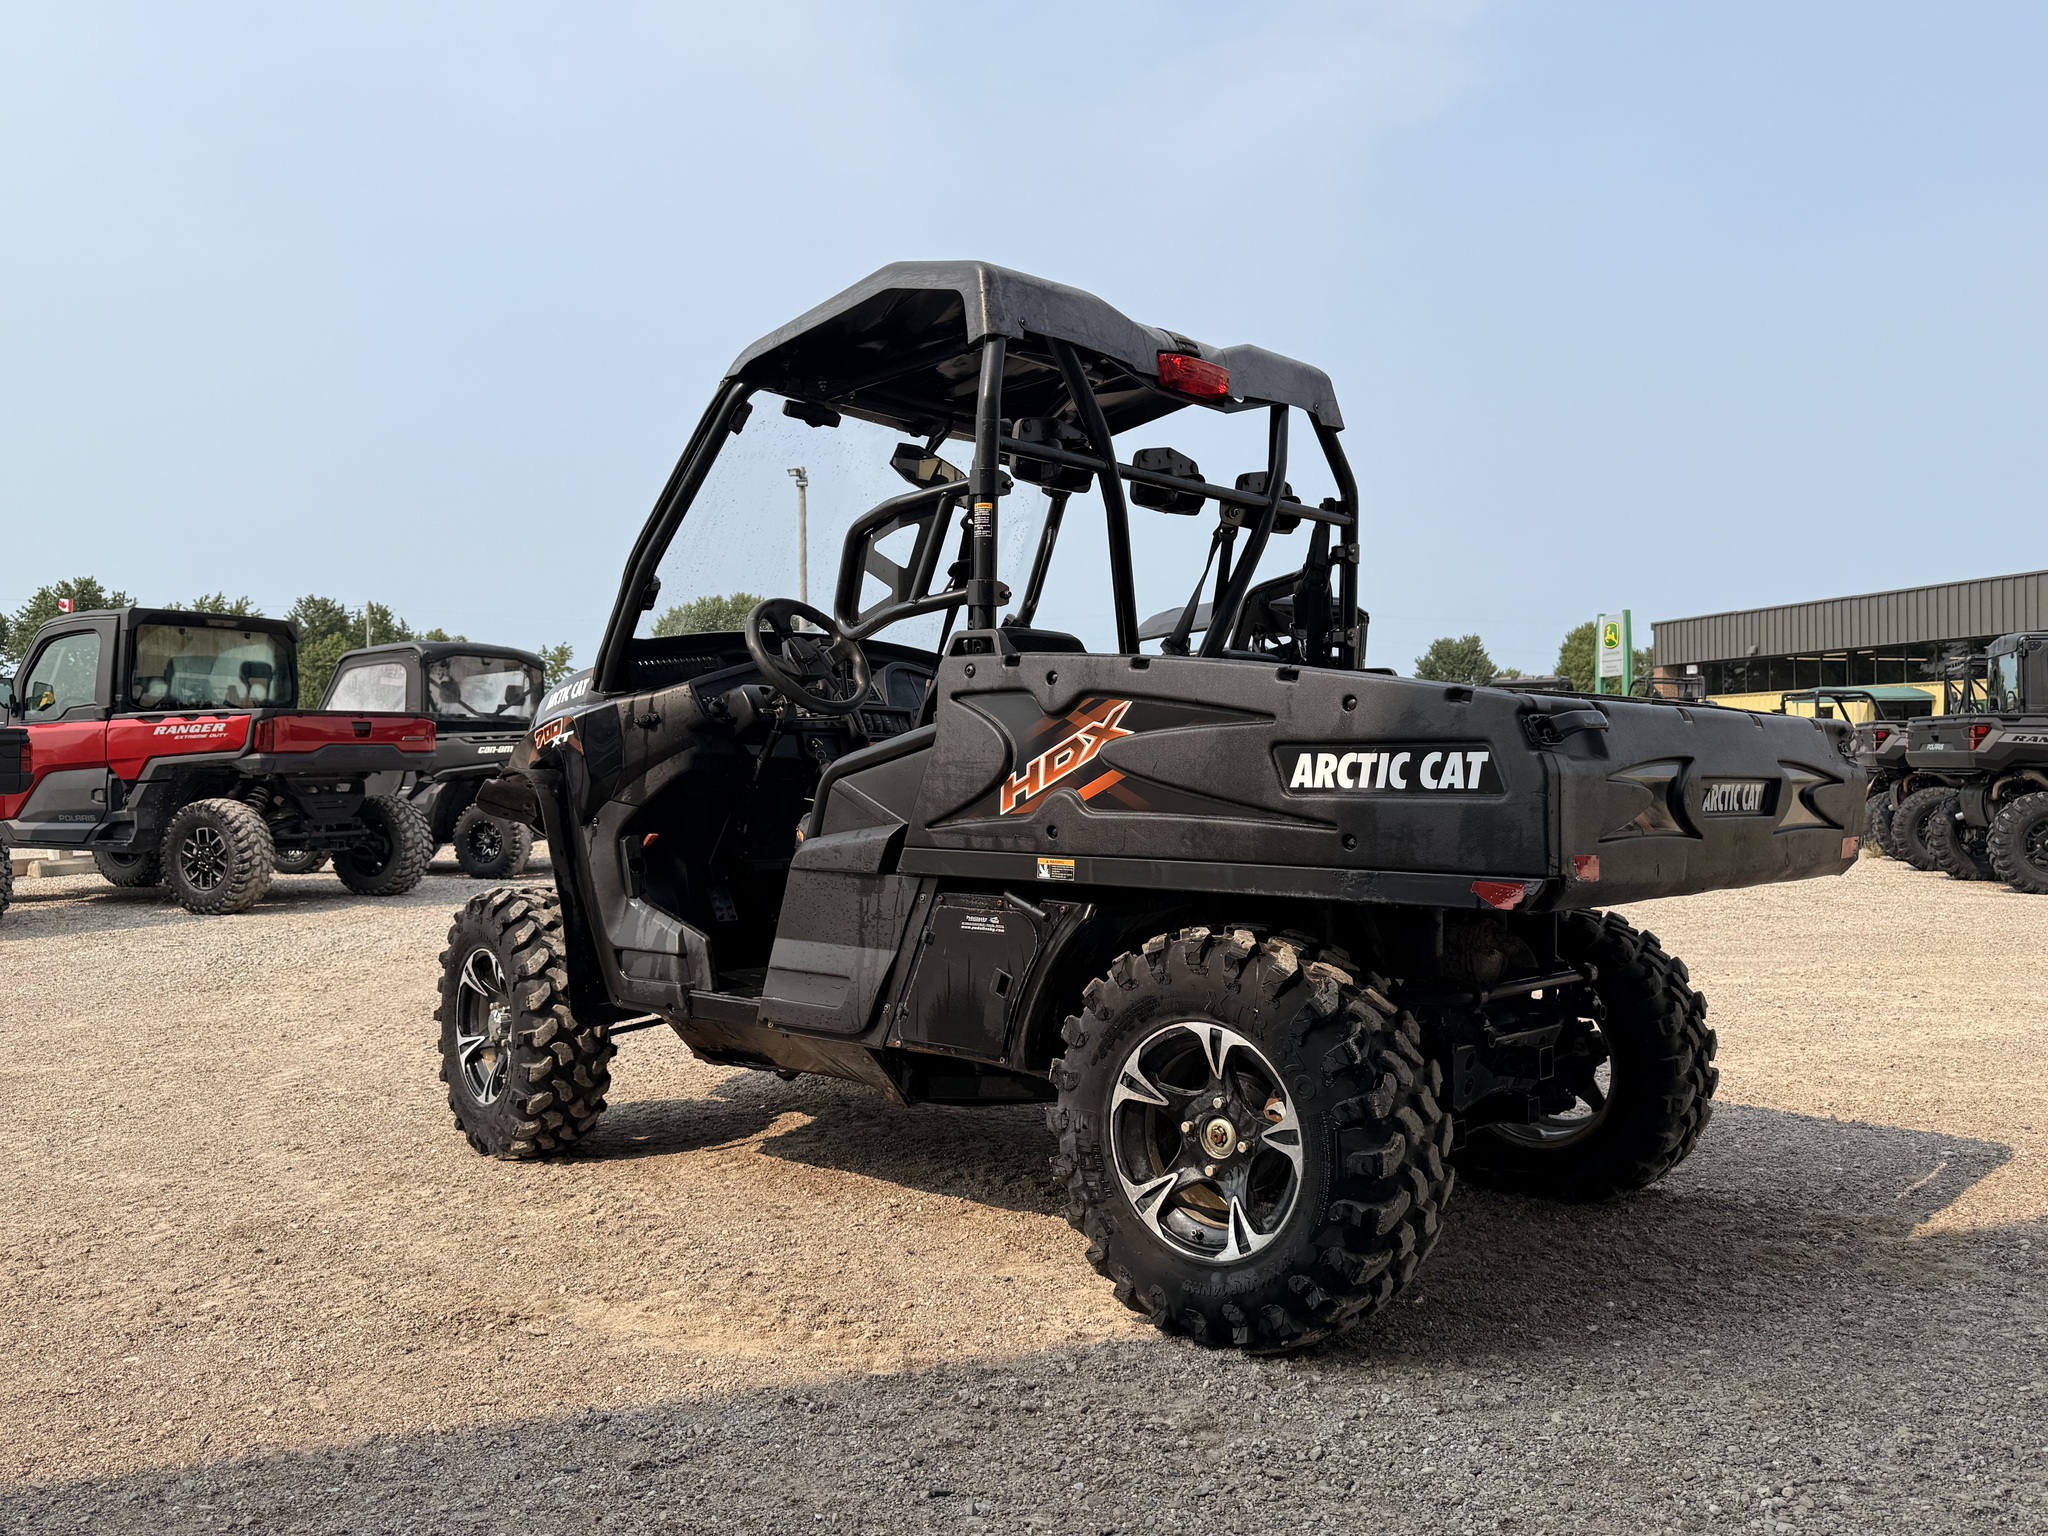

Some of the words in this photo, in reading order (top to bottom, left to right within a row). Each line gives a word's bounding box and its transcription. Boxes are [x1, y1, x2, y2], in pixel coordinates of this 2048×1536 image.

[545, 684, 573, 711] ARCTIC
[571, 678, 590, 699] CAT
[153, 723, 227, 735] RANGER
[534, 717, 563, 749] 700
[551, 730, 574, 748] XT
[1000, 700, 1135, 815] HDX
[1927, 743, 1945, 751] POLARIS
[1289, 752, 1411, 789] ARCTIC
[1419, 751, 1490, 789] CAT
[1702, 784, 1741, 812] ARCTIC
[1742, 784, 1762, 811] CAT
